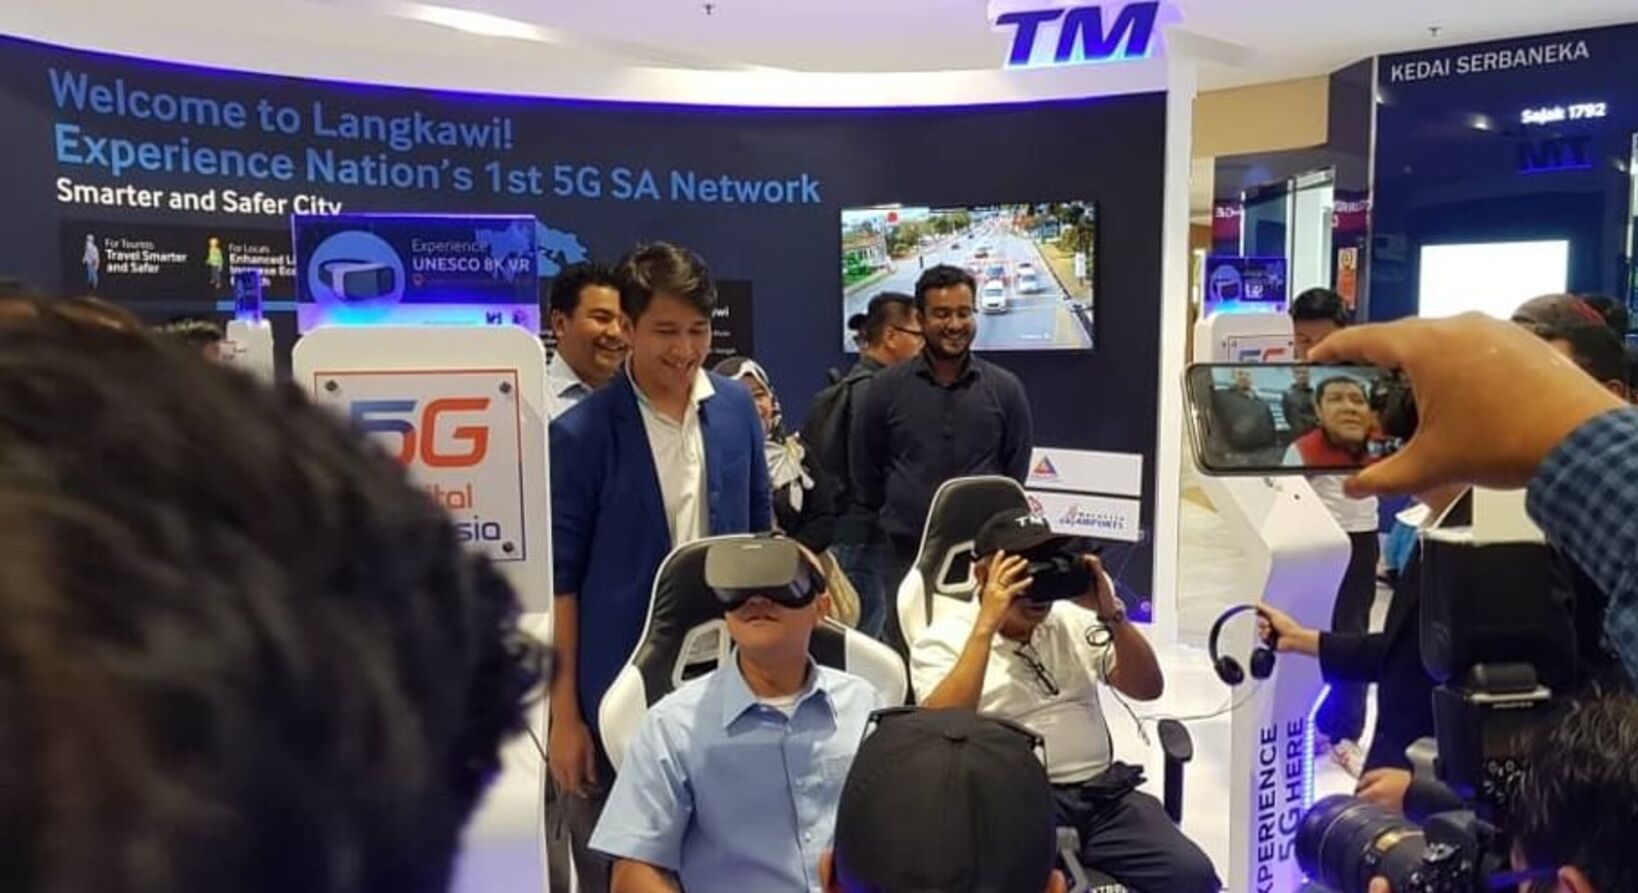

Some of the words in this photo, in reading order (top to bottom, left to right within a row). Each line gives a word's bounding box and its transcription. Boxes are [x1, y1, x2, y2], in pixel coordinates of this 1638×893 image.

[996, 1, 1159, 65] TM
[1390, 58, 1450, 82] KEDAI
[1456, 41, 1589, 75] SERBANEKA
[48, 68, 247, 129] Welcome
[256, 98, 301, 133] to
[312, 102, 514, 151] Langkawi!
[1521, 106, 1566, 124] Sejak
[1568, 102, 1607, 119] 1792
[54, 122, 295, 181] Experience
[306, 147, 474, 192] Nation's
[486, 161, 543, 195] 1st
[553, 165, 600, 199] 5G
[610, 167, 661, 200] SA
[670, 170, 822, 204] Network
[56, 177, 164, 209] Smarter
[169, 187, 216, 212] and
[222, 191, 285, 216] Safer
[293, 196, 342, 216] City
[104, 238, 119, 249] For
[229, 243, 242, 253] For
[411, 238, 488, 254] Experience
[105, 248, 141, 261] Travel
[142, 250, 188, 263] Smarter
[229, 253, 284, 265] Enhanced
[412, 258, 480, 273] UNESCO
[484, 259, 504, 273] 8K
[507, 258, 530, 273] VR
[106, 262, 129, 274] and
[130, 262, 160, 274] Safer
[349, 397, 492, 468] 5G
[1014, 515, 1046, 528] TM
[1285, 716, 1304, 803] HERE
[1257, 723, 1277, 893] XPERIENCE
